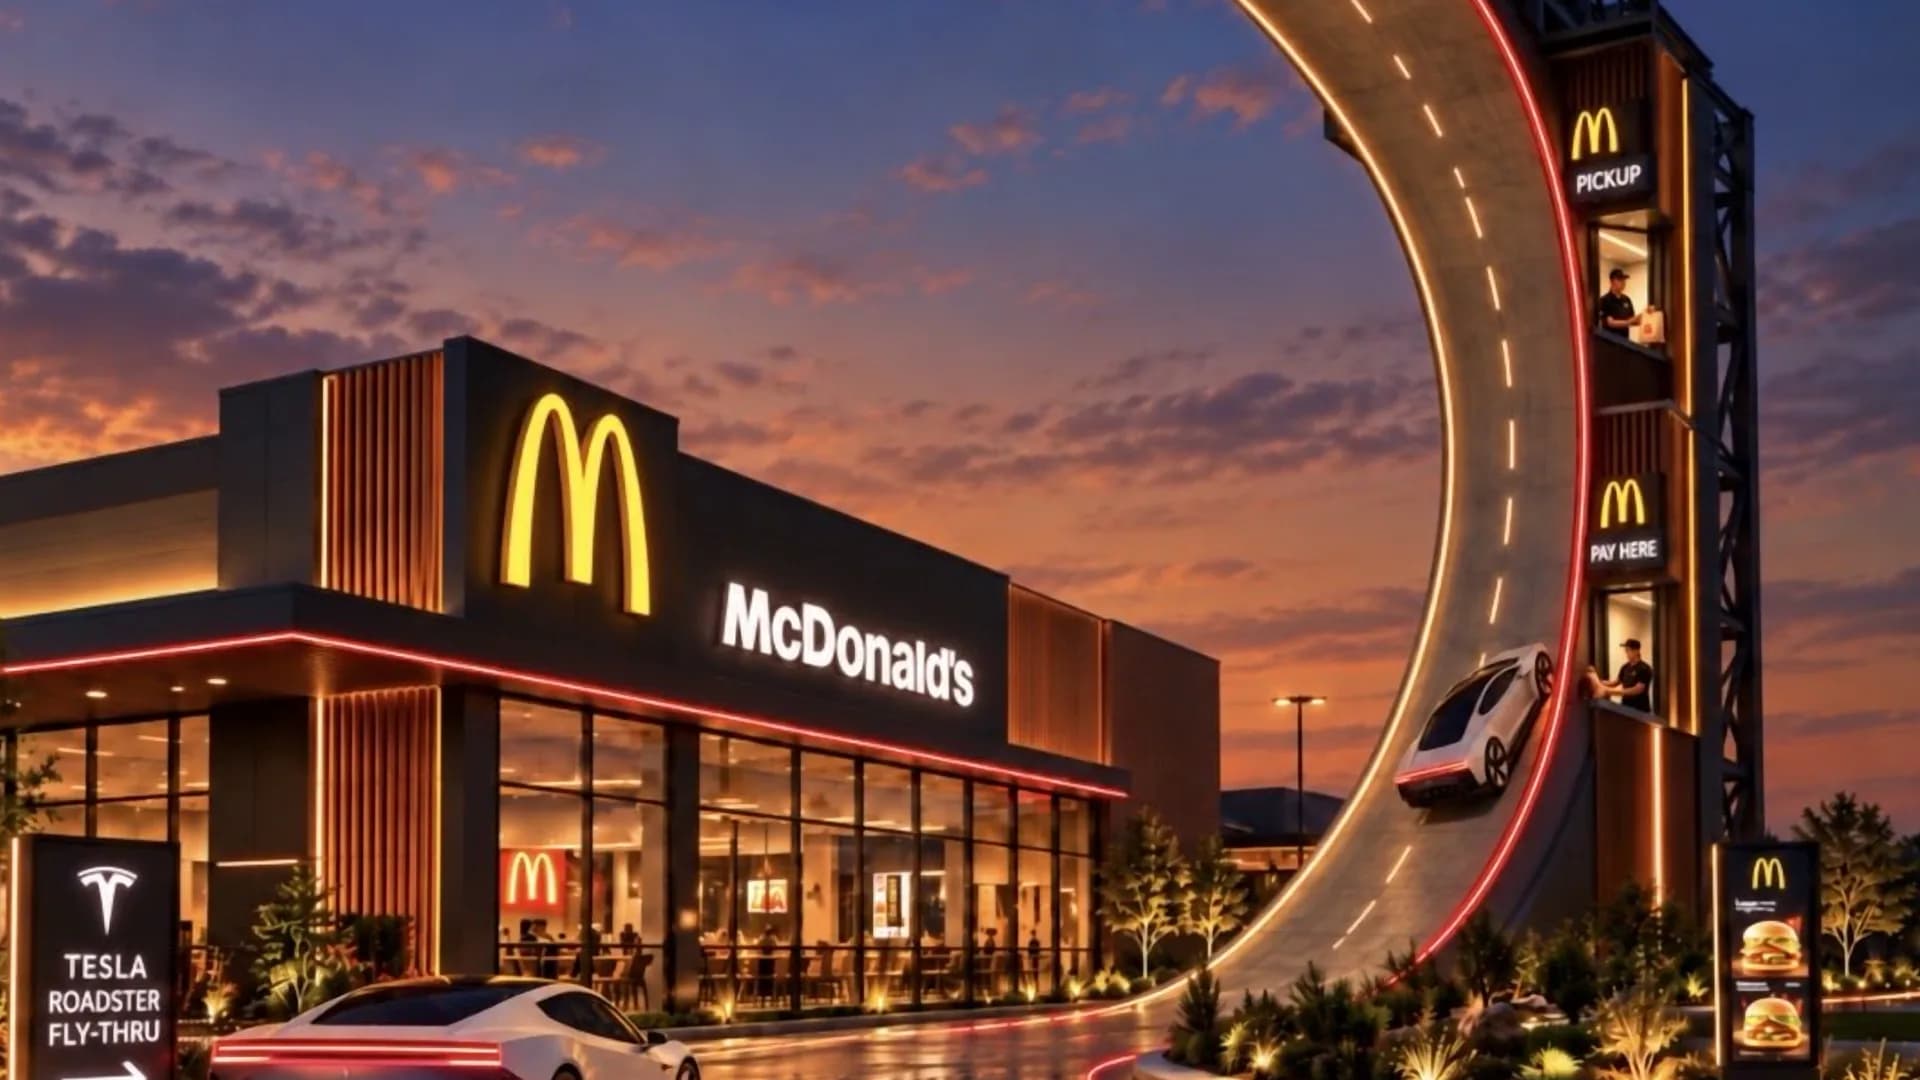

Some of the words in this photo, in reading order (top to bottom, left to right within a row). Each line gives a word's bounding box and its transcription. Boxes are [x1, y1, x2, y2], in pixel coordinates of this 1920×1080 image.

[1576, 164, 1641, 194] PICKUP
[1590, 543, 1617, 563] PAY
[1619, 539, 1658, 560] HERE
[722, 582, 974, 707] McDonald's
[64, 954, 147, 980] TESLA
[49, 989, 161, 1013] ROADSTER
[48, 1019, 161, 1046] FLY-THRU
